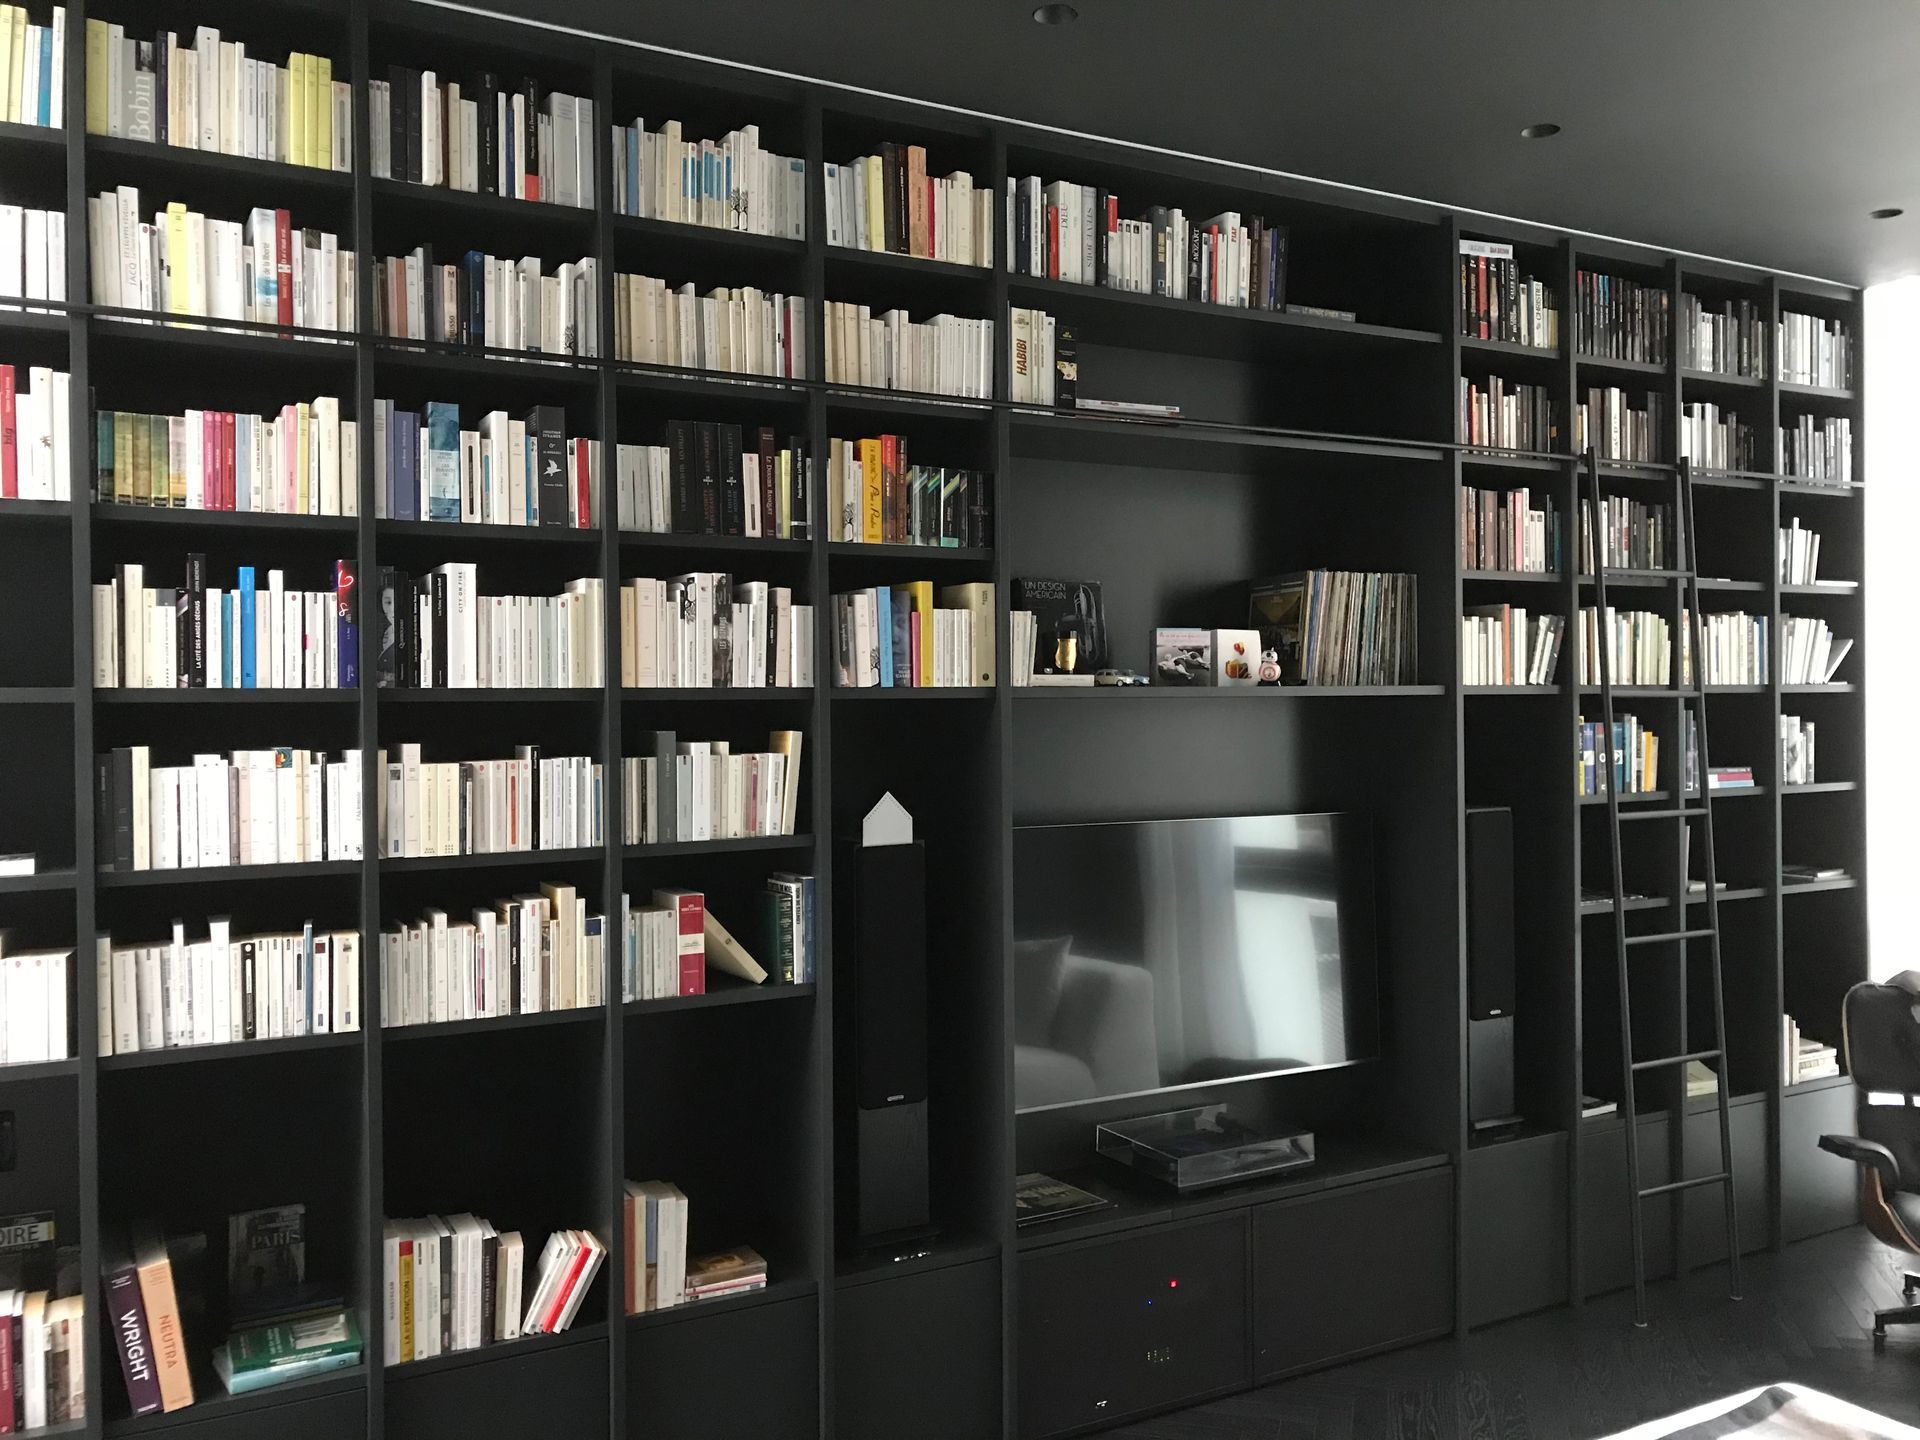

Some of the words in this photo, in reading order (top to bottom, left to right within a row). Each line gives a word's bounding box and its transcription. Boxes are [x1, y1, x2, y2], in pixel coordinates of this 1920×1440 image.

[128, 75, 152, 140] Bobin
[1191, 228, 1200, 261] MOZART
[128, 262, 138, 286] JACQ
[1016, 338, 1027, 376] HABIBI
[458, 588, 462, 596] ON
[1024, 582, 1036, 590] UN
[1037, 582, 1066, 591] DESIGN
[1025, 591, 1066, 599] AMERICAIN
[120, 1308, 150, 1382] WRIGHT
[160, 1314, 178, 1369] NEUTRA
[404, 1336, 410, 1345] LA
